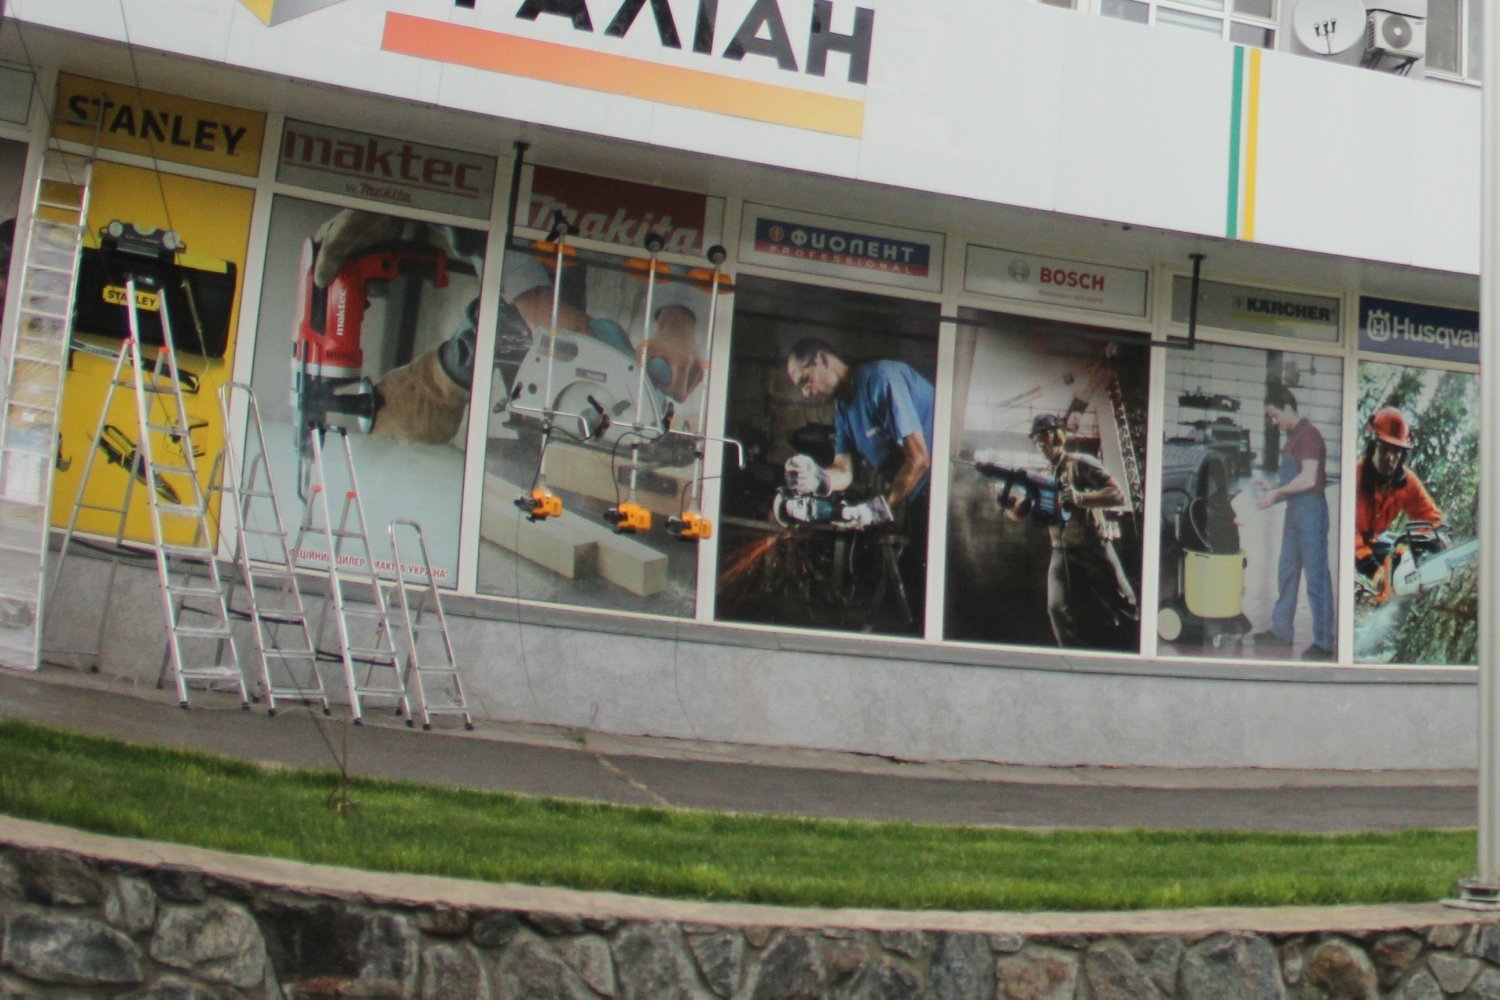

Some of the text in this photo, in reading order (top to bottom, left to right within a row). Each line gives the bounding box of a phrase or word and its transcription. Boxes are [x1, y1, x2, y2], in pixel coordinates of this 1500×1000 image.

[68, 93, 248, 157] STANLEY
[284, 129, 483, 192] maktec
[768, 244, 913, 273] PROFESSIONAL
[1039, 266, 1105, 291] BOSCH
[107, 289, 158, 308] STALEY
